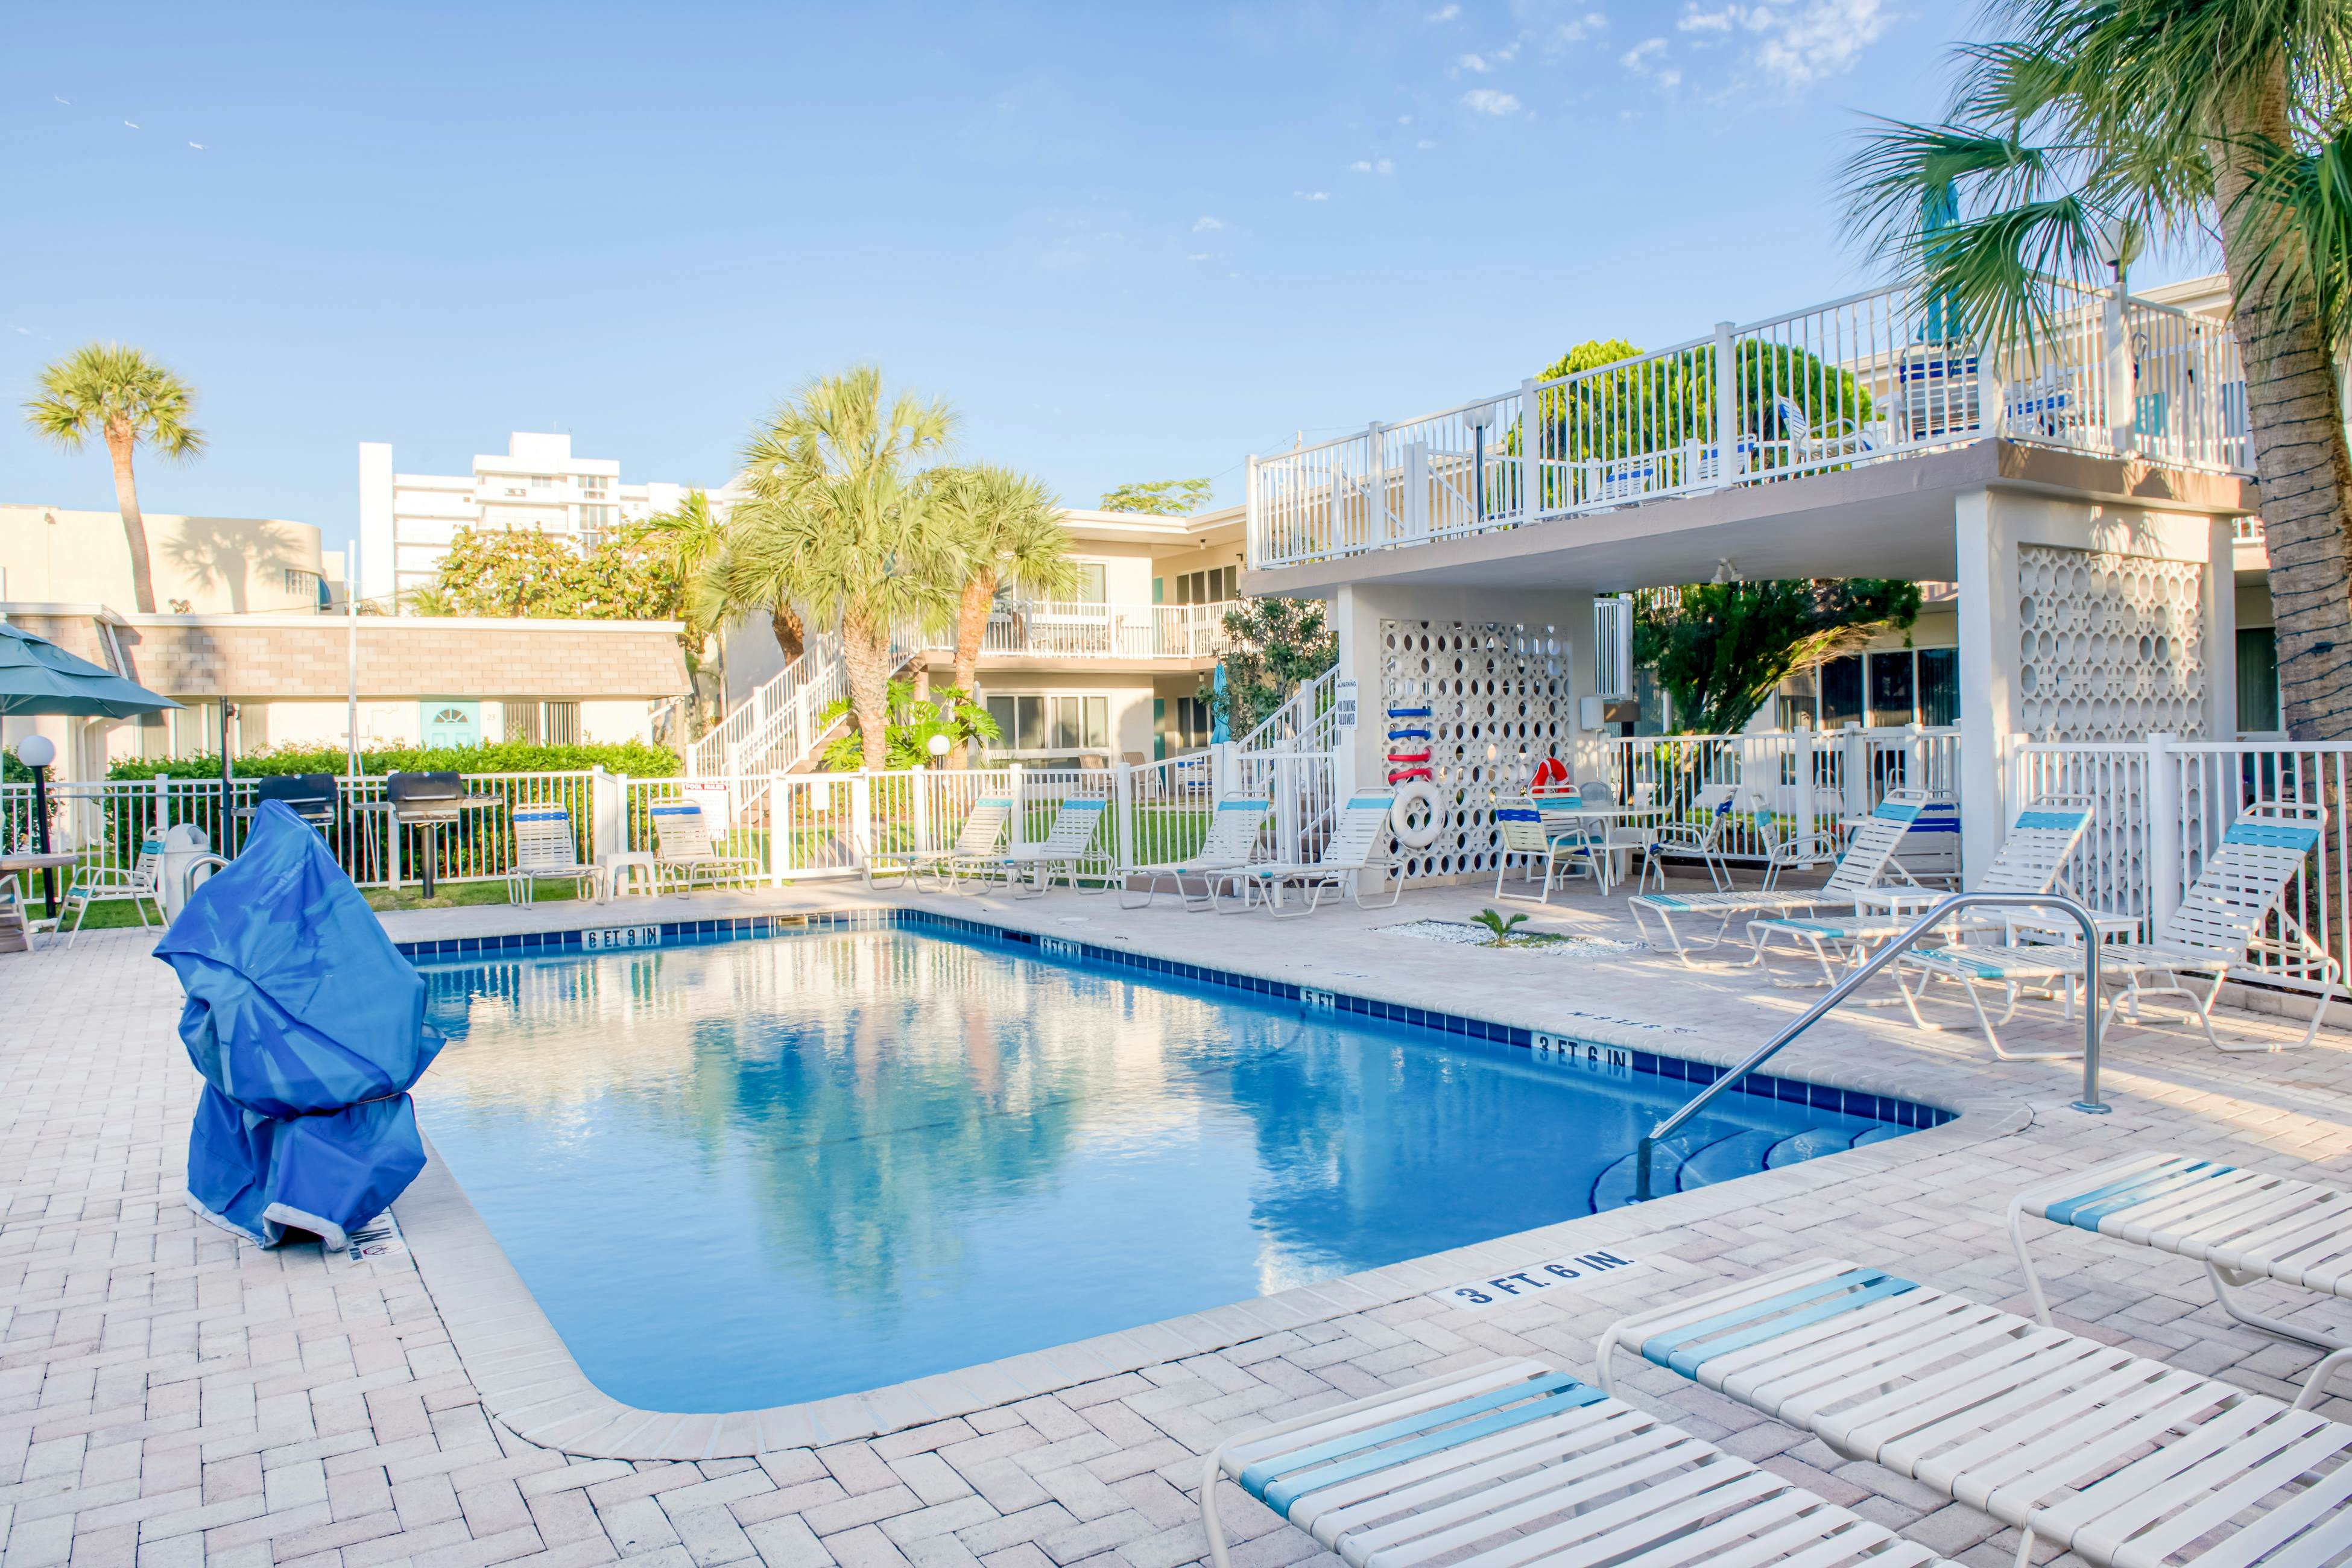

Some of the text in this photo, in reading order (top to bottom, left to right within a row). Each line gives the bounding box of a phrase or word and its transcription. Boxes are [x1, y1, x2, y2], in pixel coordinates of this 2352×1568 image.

[1337, 700, 1356, 712] NO DIVING
[1339, 713, 1355, 725] ALLOWED
[1306, 990, 1333, 1006] 5 FT
[1540, 1036, 1626, 1067] 3 FT 6 IN
[1455, 1251, 1635, 1303] 3 FT. 6 IN.
